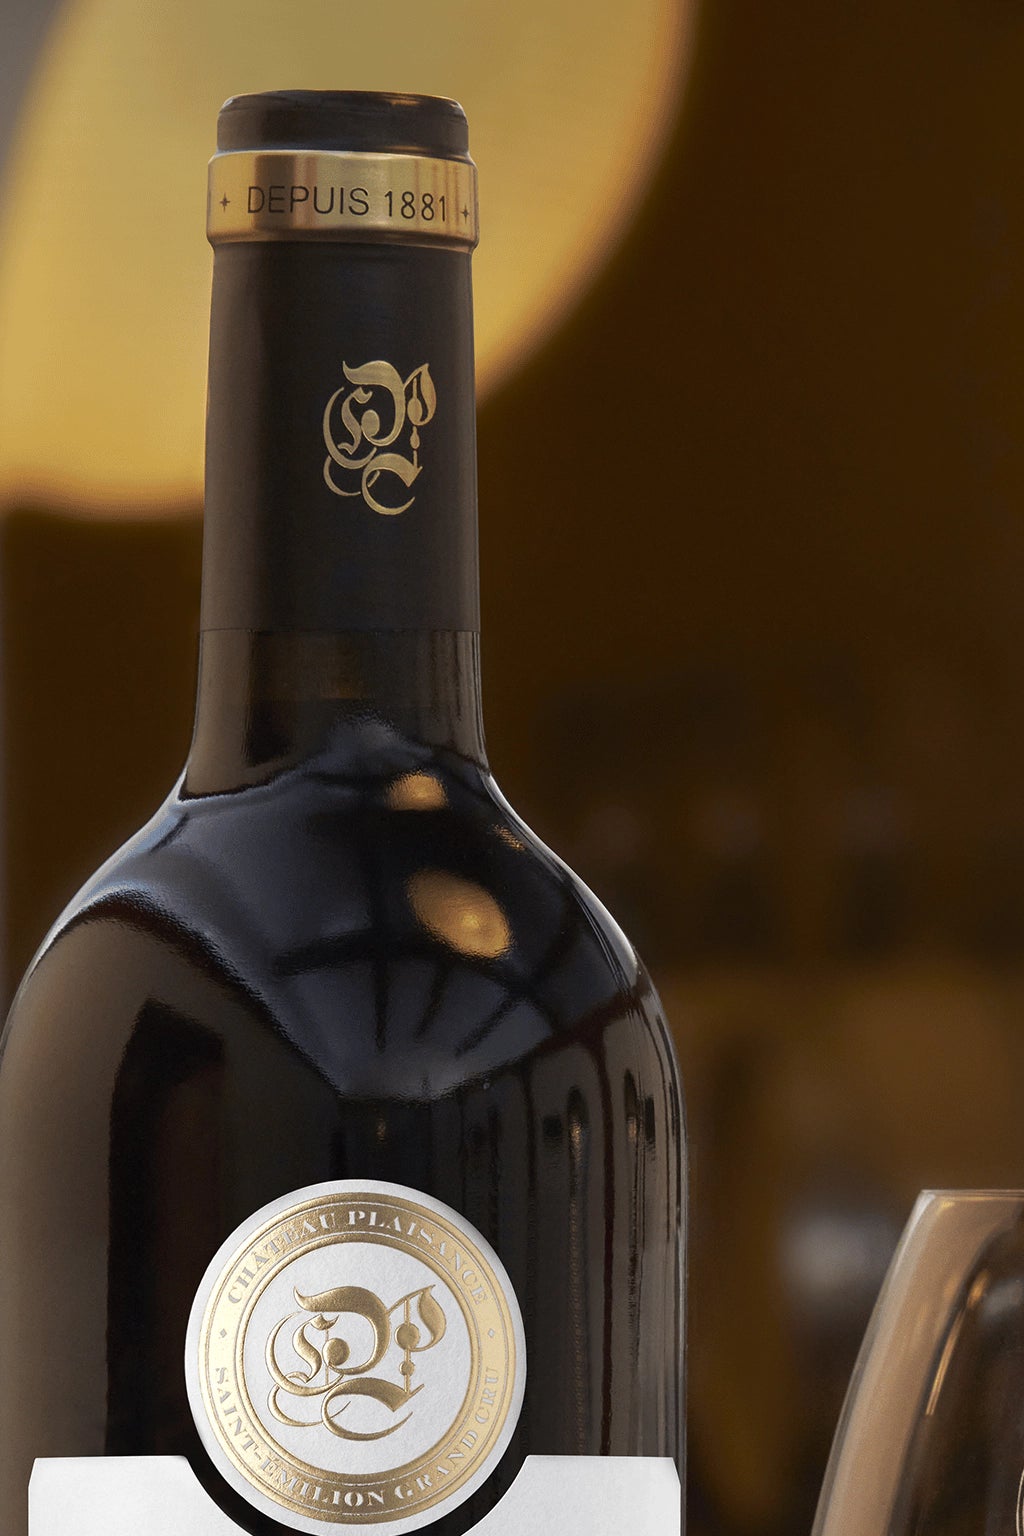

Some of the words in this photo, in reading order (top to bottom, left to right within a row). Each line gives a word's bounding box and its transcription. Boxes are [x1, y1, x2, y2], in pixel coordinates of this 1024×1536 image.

[247, 185, 370, 217] DEPUIS
[383, 190, 447, 223] 1881
[227, 1211, 337, 1305] CHÂTEAU
[348, 1210, 489, 1305] PLAISANCE
[394, 1428, 481, 1499] GRAND
[473, 1366, 501, 1424] CRU
